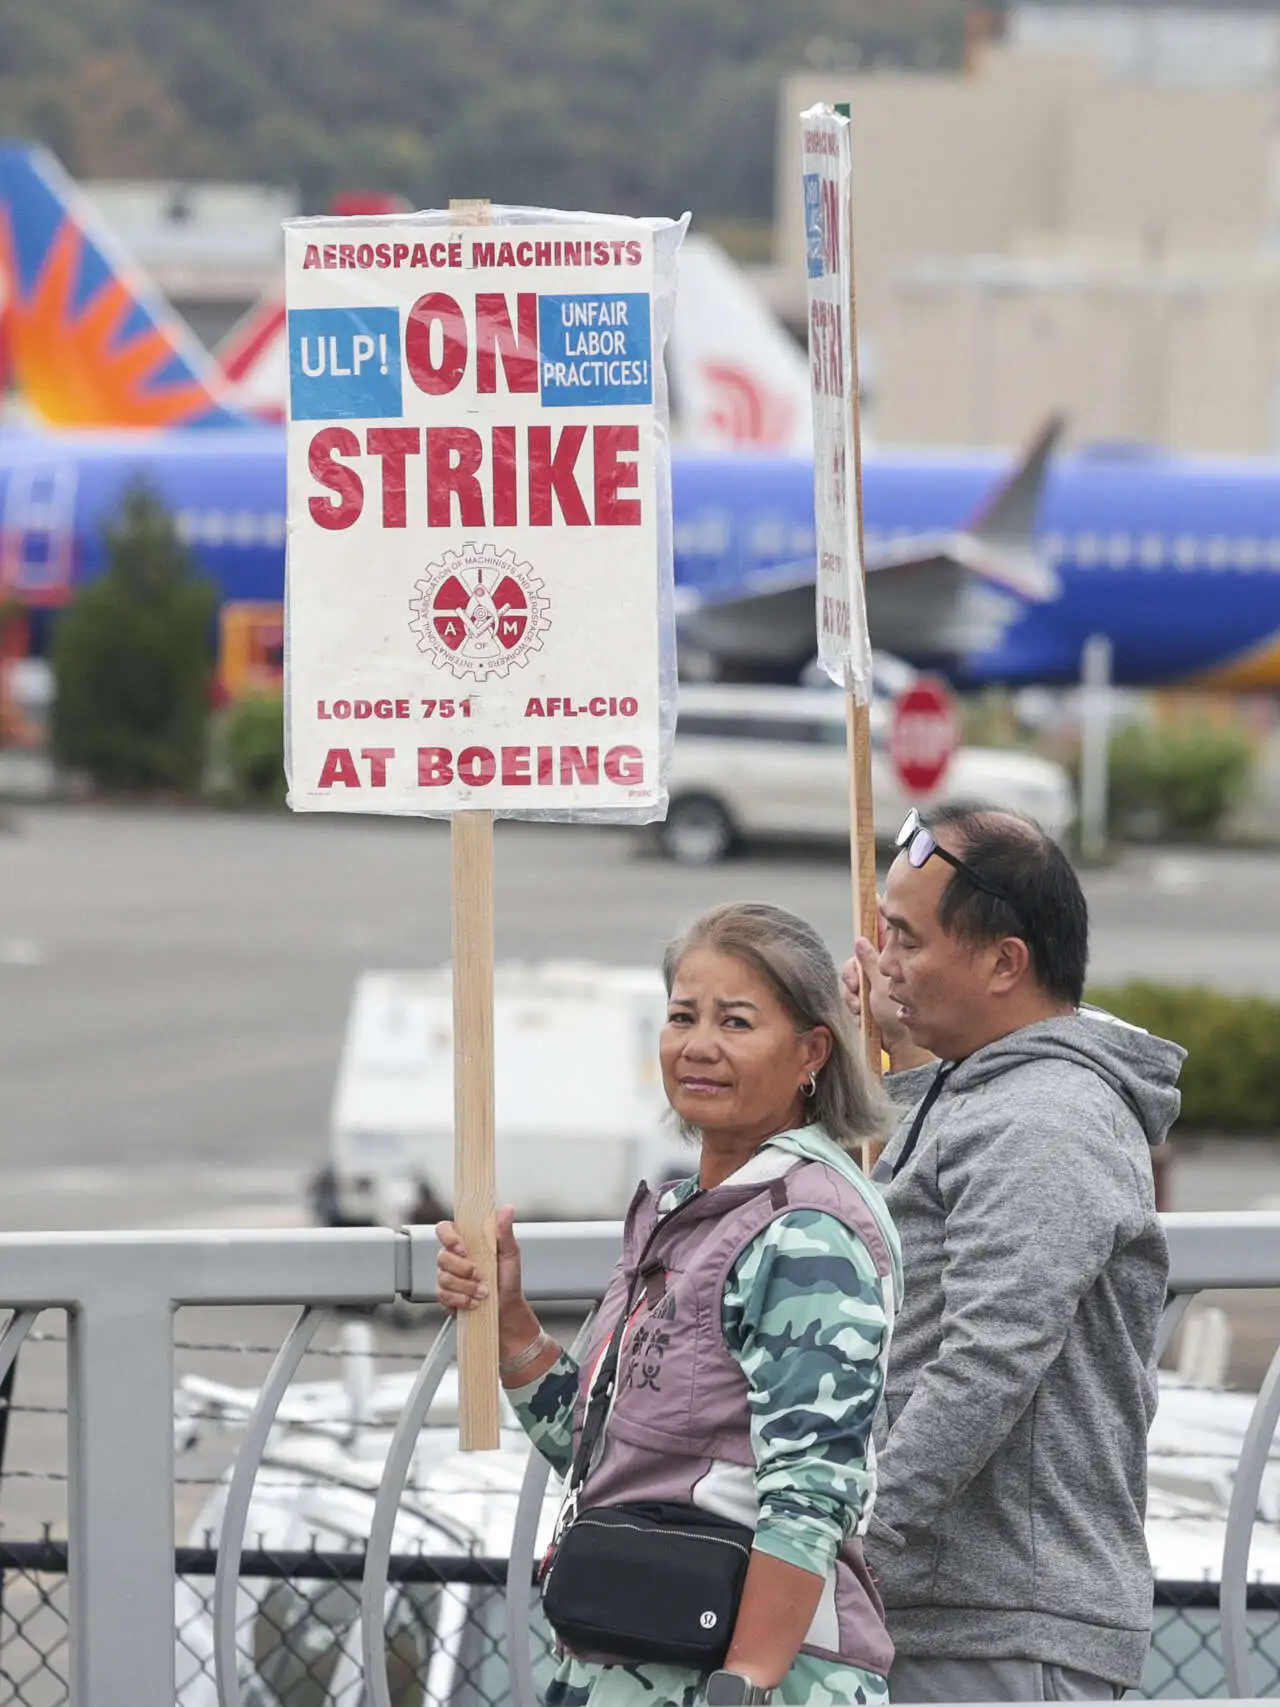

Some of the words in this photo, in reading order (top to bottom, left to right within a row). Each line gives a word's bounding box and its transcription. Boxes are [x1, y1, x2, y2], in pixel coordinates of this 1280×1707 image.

[303, 242, 462, 270] AEROSPACE
[472, 240, 642, 268] MACHINISTS
[561, 301, 628, 327] UNFAIR
[301, 334, 388, 378] ULP!
[406, 291, 538, 395] ON
[565, 330, 627, 356] LABOR
[543, 360, 648, 388] PRACTICES!
[308, 425, 642, 530] STRIKE
[444, 621, 457, 636] A
[503, 621, 518, 635] M
[317, 699, 410, 720] LODGE
[420, 698, 471, 719] 751
[524, 696, 639, 717] AFL-CIO
[318, 747, 396, 788] AT
[417, 745, 644, 786] BOEING
